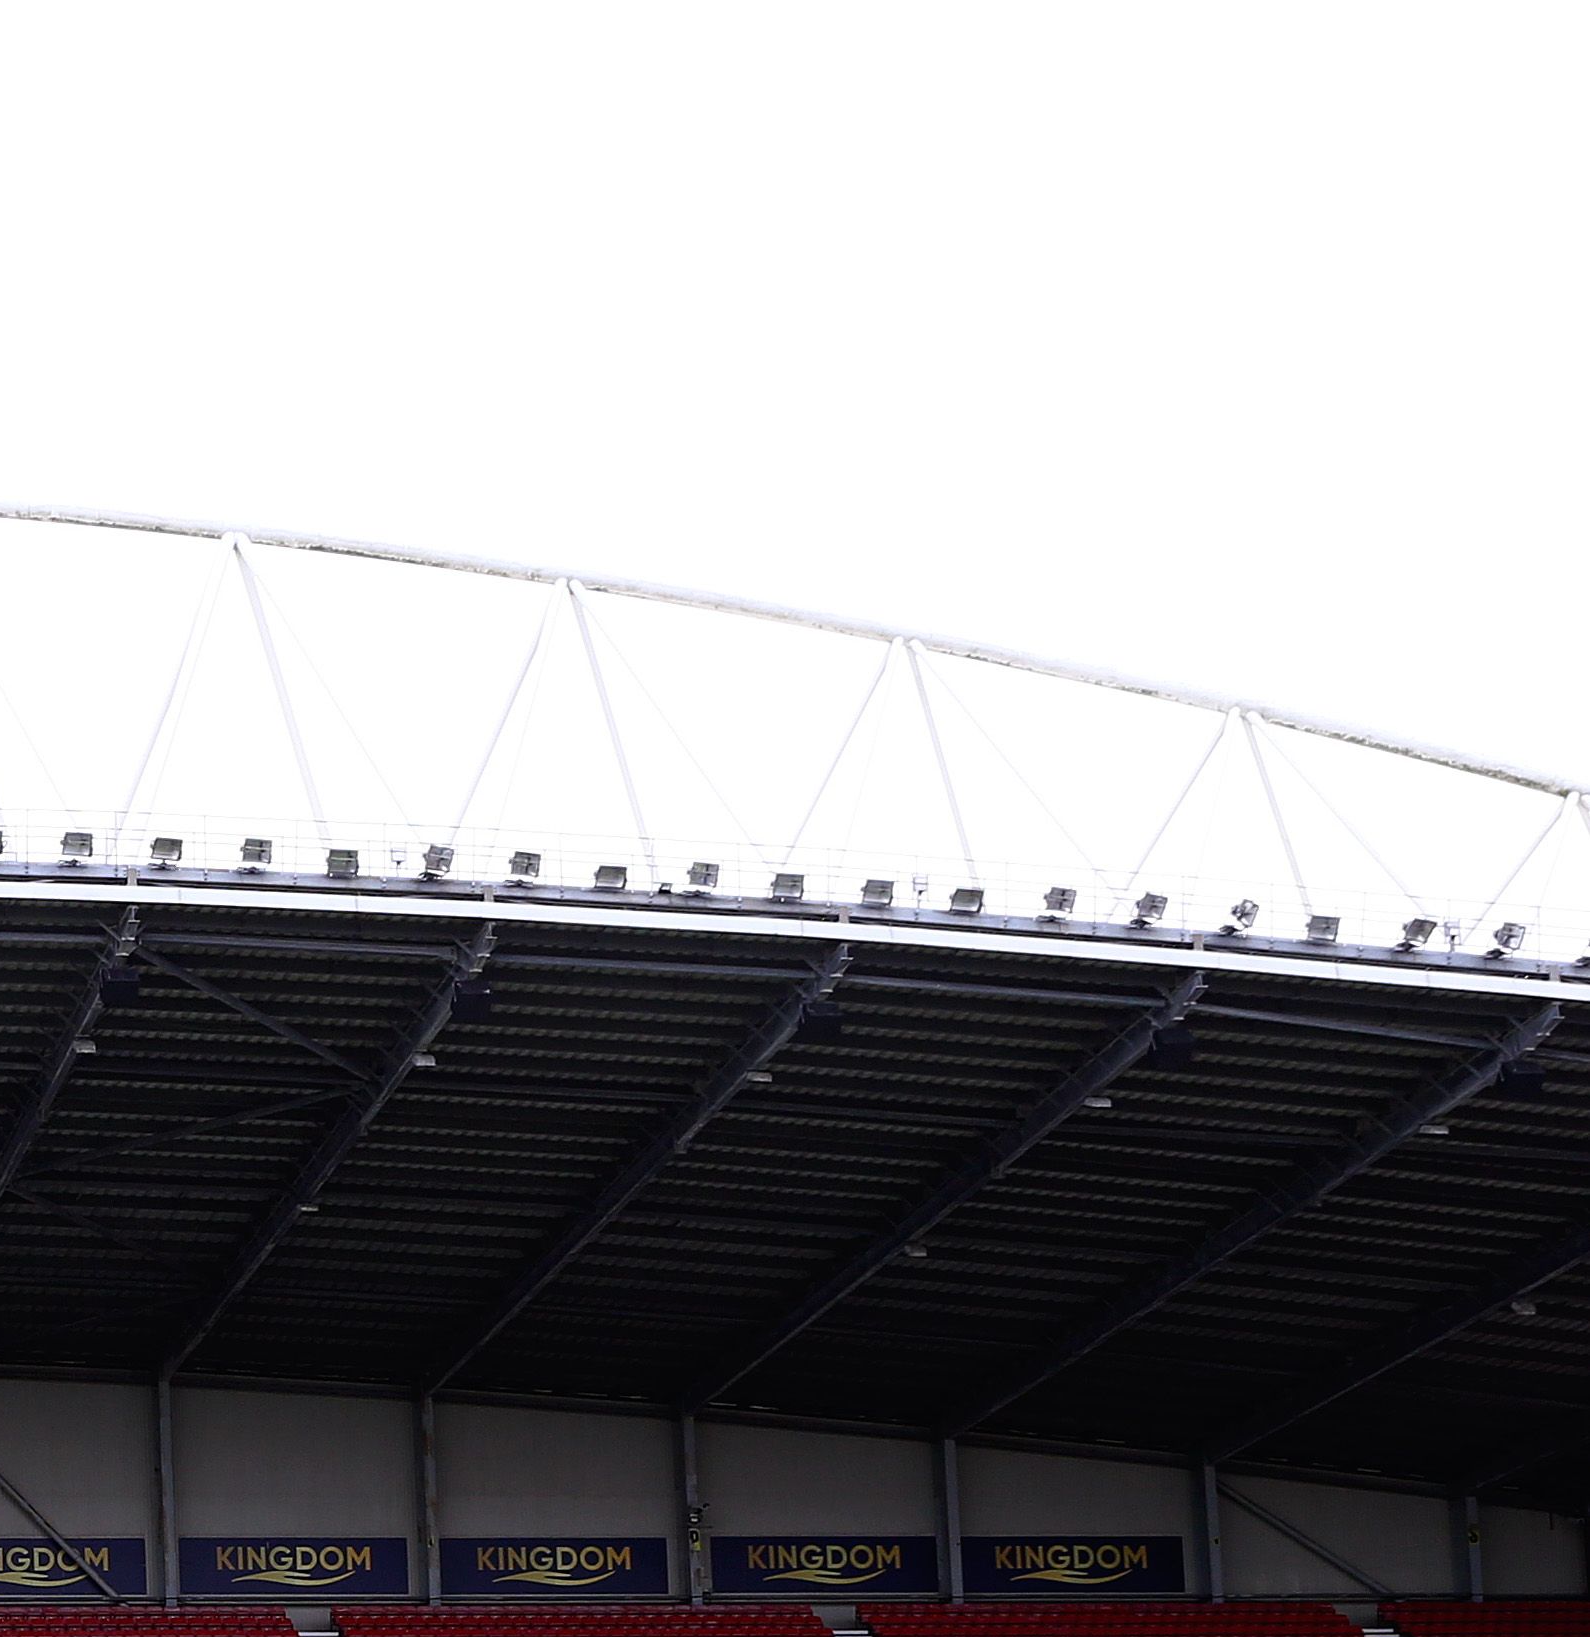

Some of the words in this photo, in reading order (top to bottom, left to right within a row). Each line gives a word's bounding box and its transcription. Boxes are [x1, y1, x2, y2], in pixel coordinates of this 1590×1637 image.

[216, 1546, 372, 1570] KINGDOM
[477, 1546, 632, 1570] KINGDOM
[748, 1545, 902, 1569] KINGDOM
[995, 1545, 1148, 1569] KINGDOM
